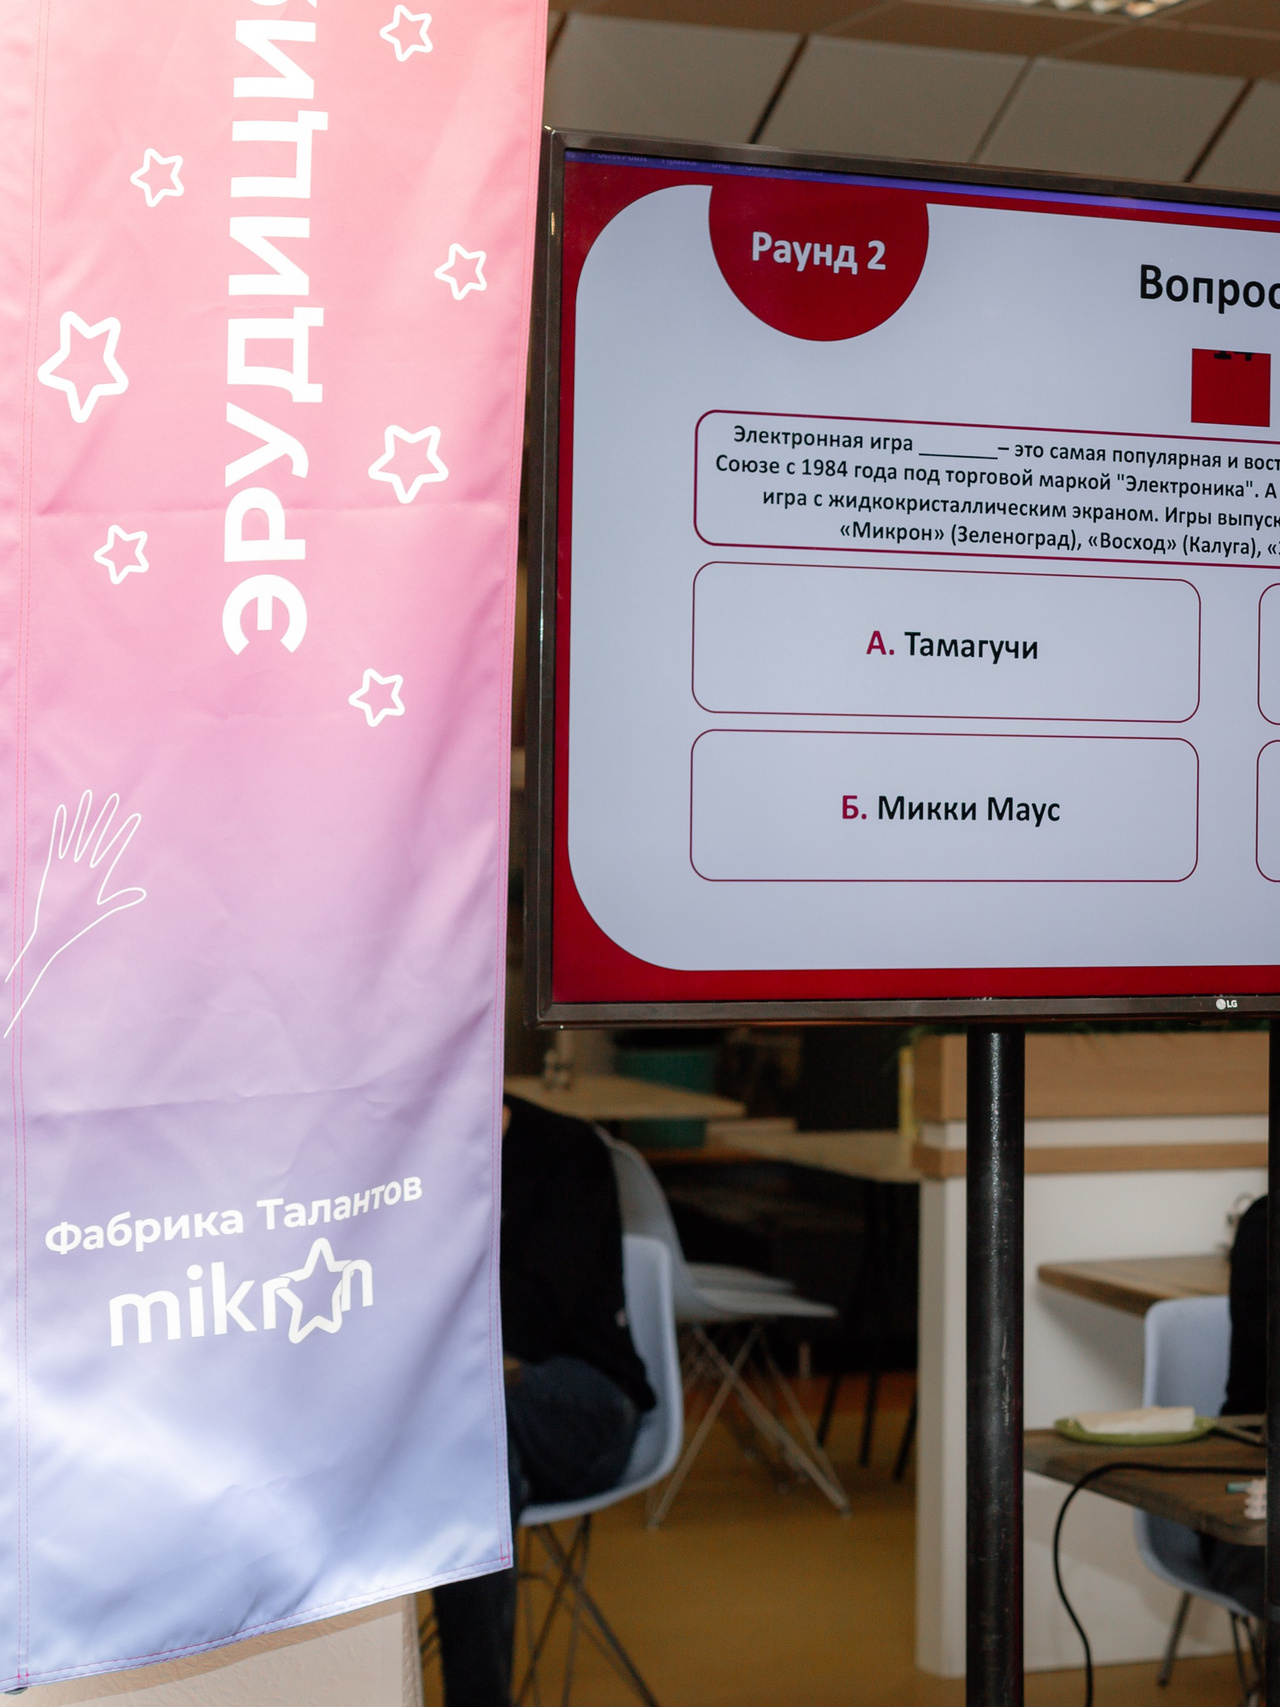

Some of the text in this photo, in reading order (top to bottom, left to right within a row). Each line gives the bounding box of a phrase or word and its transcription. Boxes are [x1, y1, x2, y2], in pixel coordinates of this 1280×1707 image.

[753, 232, 886, 274] Раунд 2
[223, 0, 328, 655] ЭРУДИЦИ
[733, 424, 864, 450] Электронная
[870, 436, 913, 455] игра
[1014, 444, 1044, 459] это
[1049, 446, 1106, 462] самая
[1112, 449, 1222, 470] популярная
[1227, 455, 1239, 469] и
[715, 453, 780, 475] Союзе
[786, 461, 796, 476] с
[801, 458, 849, 478] 1984
[854, 465, 897, 484] года
[903, 467, 941, 486] под
[945, 468, 1033, 488] торговой
[1038, 472, 1111, 493] маркой
[1116, 473, 1259, 499] "Электроника".
[1264, 482, 1278, 500] А
[763, 491, 807, 510] игра
[813, 493, 823, 507] с
[828, 494, 1067, 518] жидкокристаллическим
[1071, 505, 1159, 524] экраном.
[1165, 506, 1212, 528] Игры
[839, 520, 945, 545] «Микрон»
[950, 523, 1082, 552] (Зеленоград),
[1087, 531, 1177, 555] «Восход»
[1182, 534, 1262, 559] (Калуга),
[866, 630, 1038, 665] А. Тамагучи
[842, 795, 1060, 828] Б. Микки Маус
[1226, 999, 1238, 1008] LG
[45, 1176, 423, 1255] Фабрика Талантов
